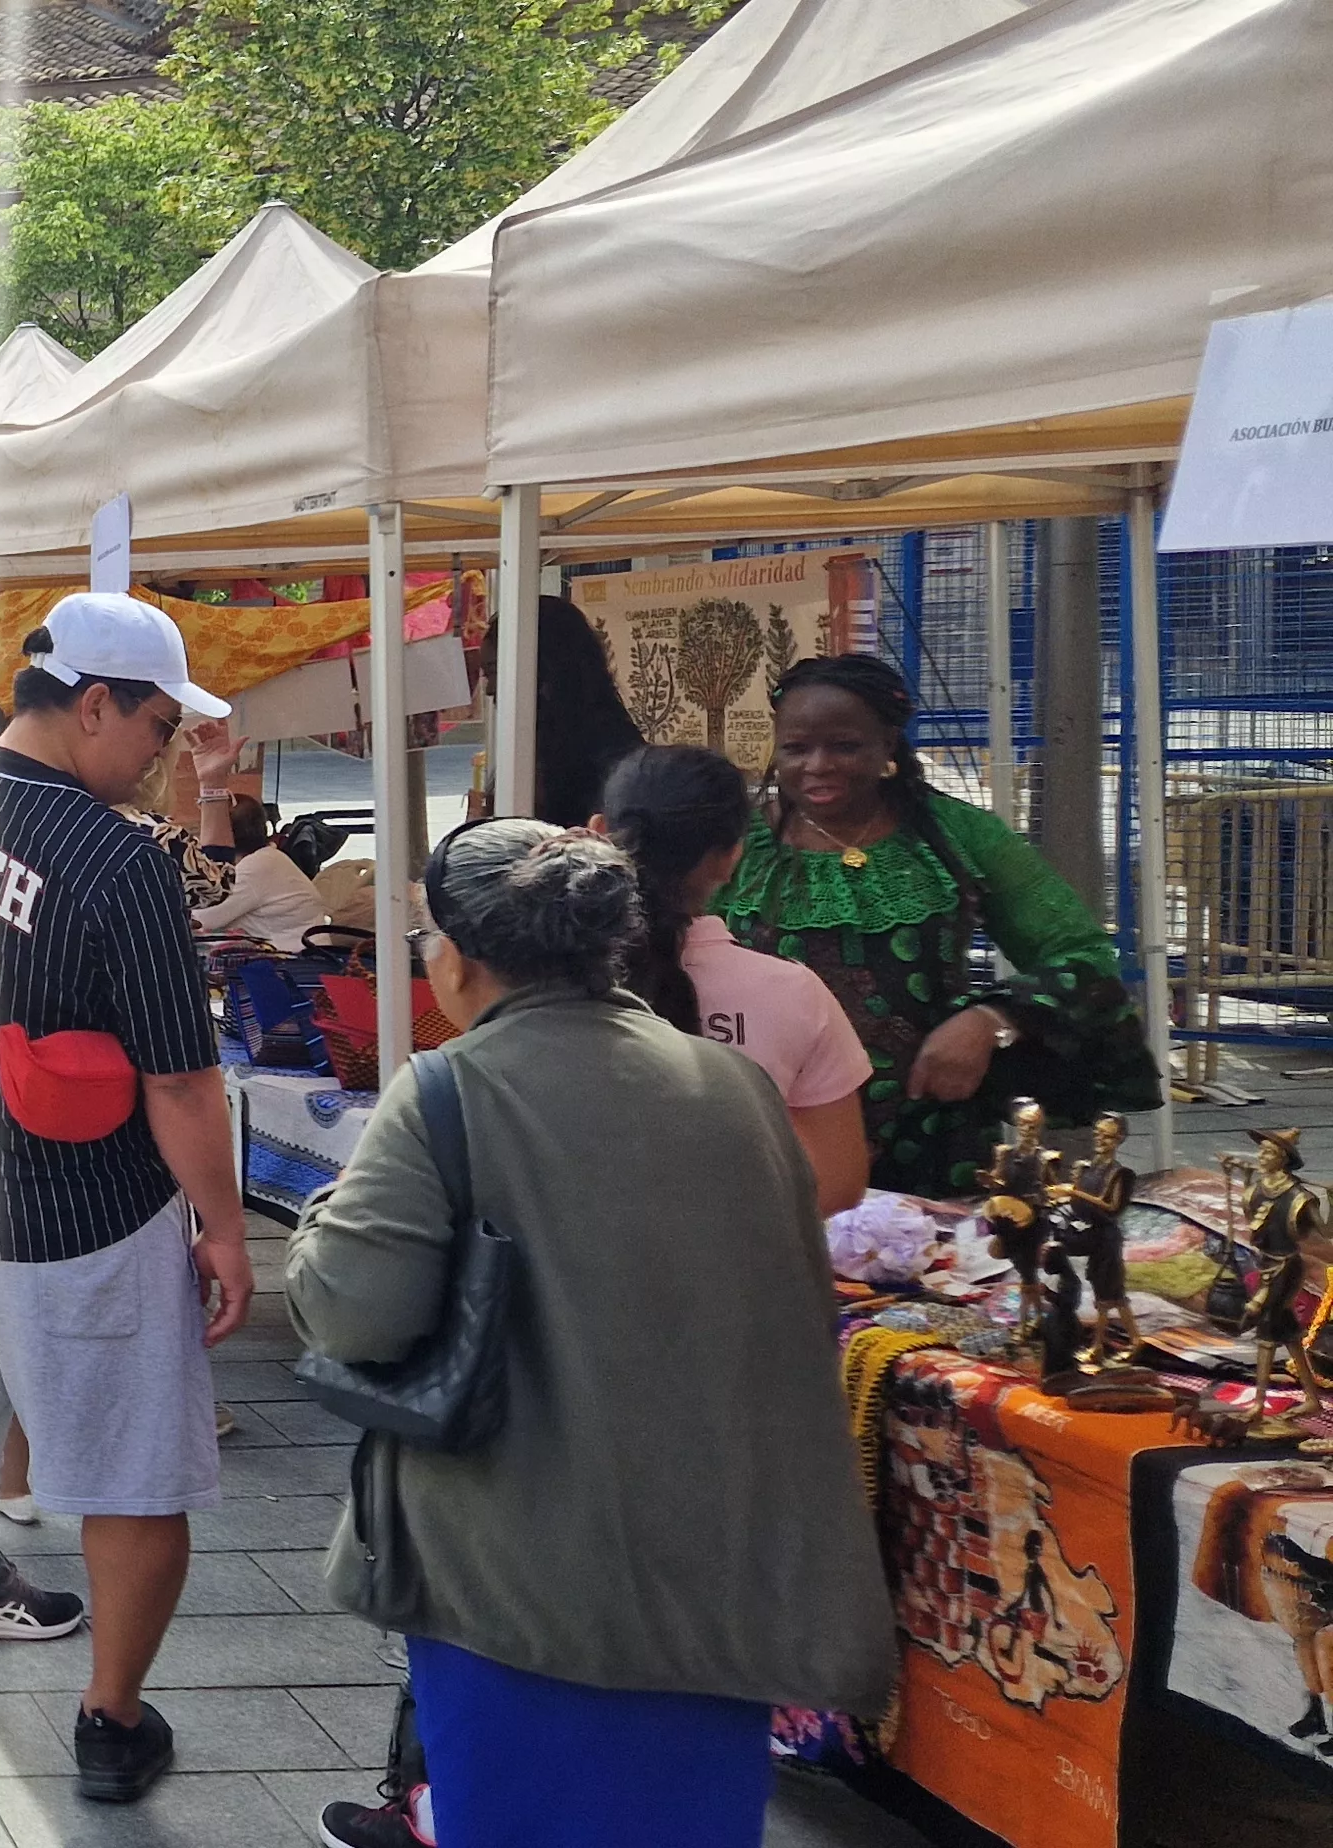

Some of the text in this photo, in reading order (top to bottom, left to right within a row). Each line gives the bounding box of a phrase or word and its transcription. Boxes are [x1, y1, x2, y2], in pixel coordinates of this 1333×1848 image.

[1229, 417, 1333, 441] ASOCIACIÓN BU
[623, 570, 704, 596] Sembrando
[709, 556, 806, 588] Solidaridad
